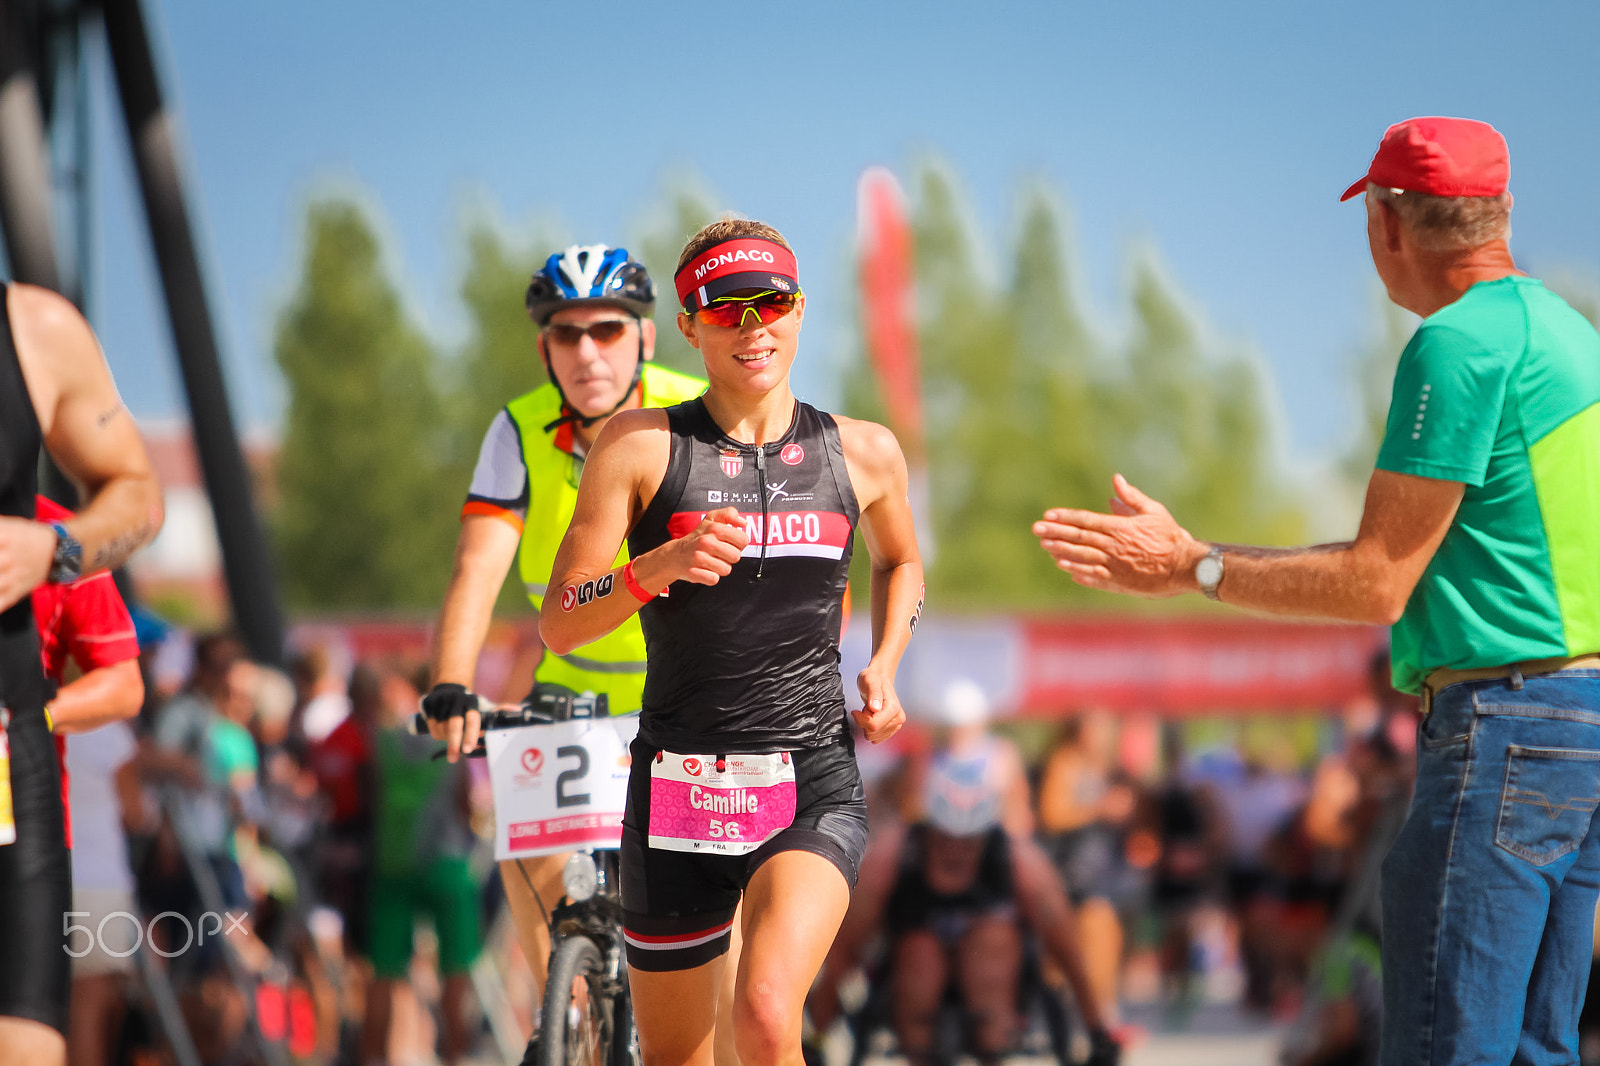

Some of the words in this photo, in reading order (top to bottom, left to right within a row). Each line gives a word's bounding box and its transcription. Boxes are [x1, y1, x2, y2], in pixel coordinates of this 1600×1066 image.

[694, 249, 775, 280] MONACO
[701, 513, 820, 545] NACO
[556, 744, 592, 809] 2
[690, 785, 759, 815] Camille
[708, 818, 741, 839] 56
